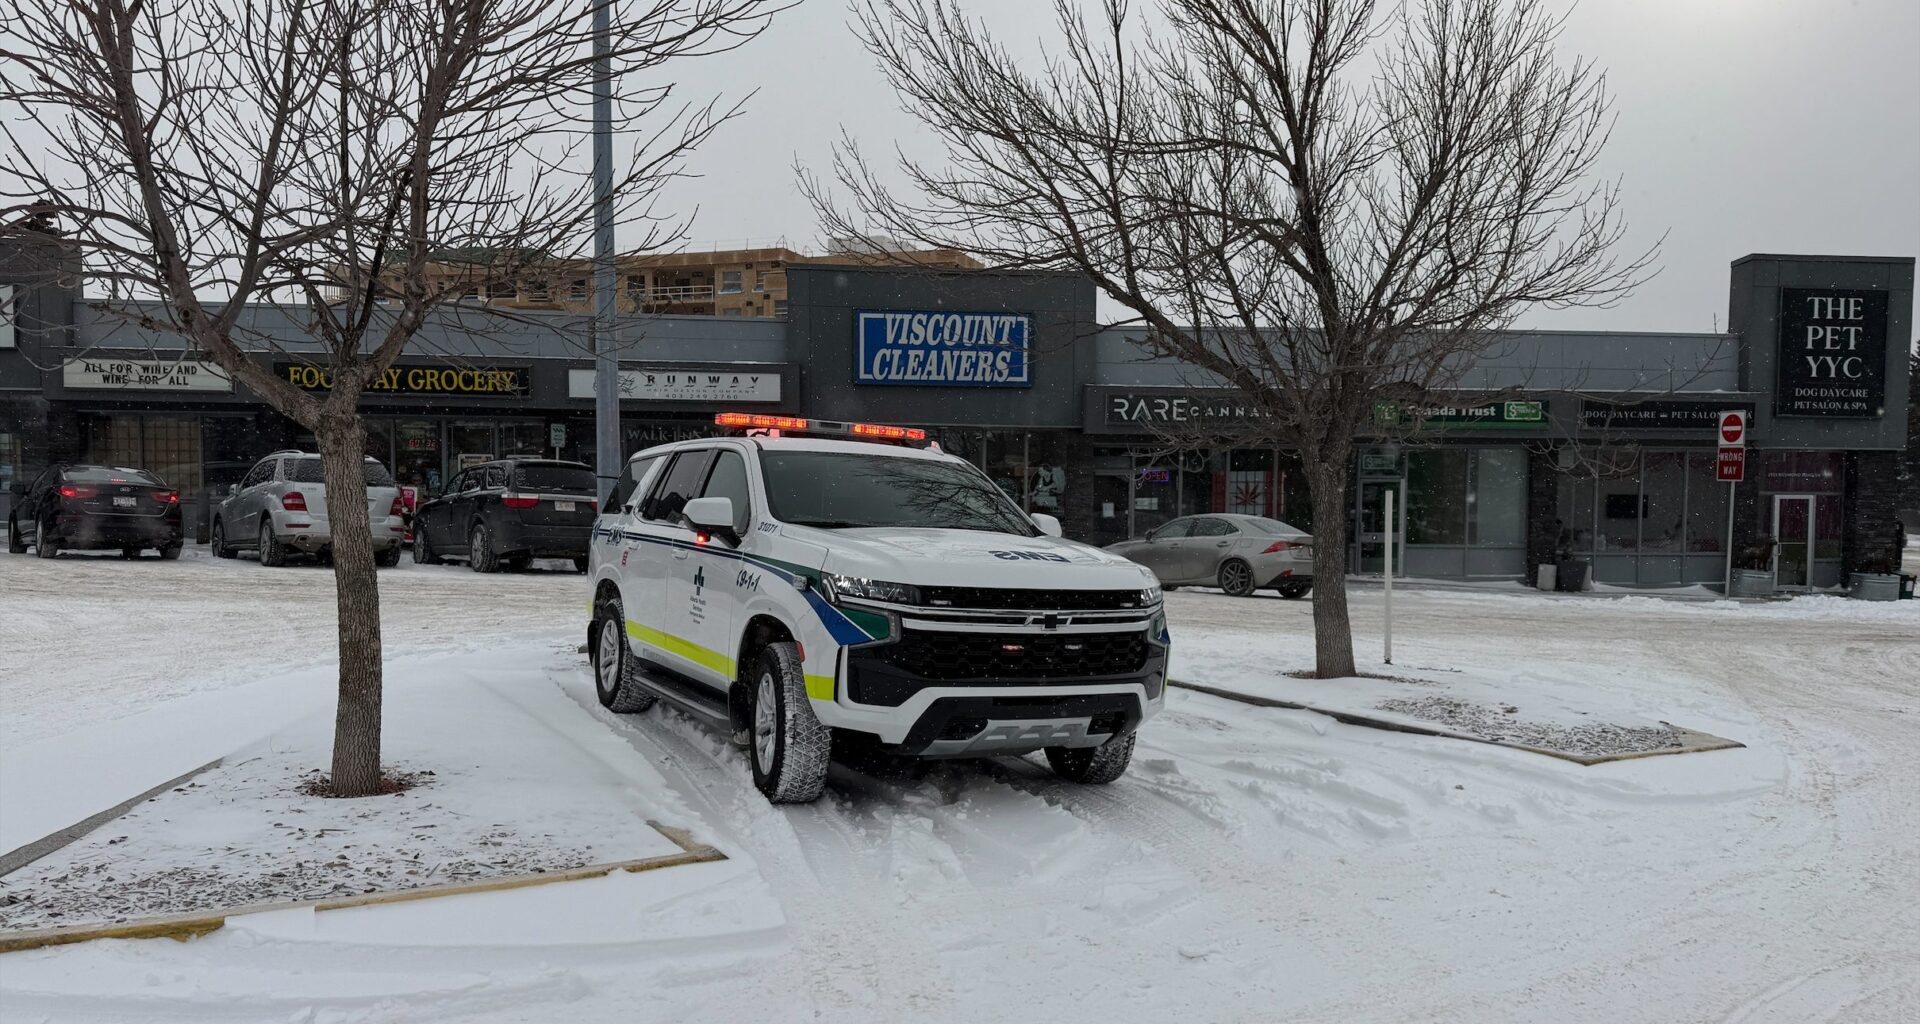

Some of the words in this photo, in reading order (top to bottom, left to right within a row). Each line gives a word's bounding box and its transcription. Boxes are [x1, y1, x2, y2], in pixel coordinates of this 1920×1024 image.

[1806, 296, 1864, 320] THE
[884, 313, 1017, 346] VISCOUNT
[1805, 325, 1863, 350] PET
[84, 363, 103, 373] ALL
[110, 363, 132, 374] FOR
[142, 365, 169, 375] WINE
[177, 365, 197, 375] AND
[872, 348, 1011, 383] CLEANERS
[1805, 356, 1863, 379] YYC
[102, 374, 129, 384] WINE
[139, 375, 159, 385] FOR
[168, 376, 189, 386] ALL
[289, 367, 402, 390] FOOAY
[408, 368, 516, 392] GROCERY
[646, 374, 760, 386] RUNWAY
[1795, 387, 1818, 397] DOG
[1820, 388, 1869, 398] DAYCARE
[1113, 398, 1188, 421] RARE
[1794, 401, 1811, 409] PET
[1812, 401, 1841, 410] SALON
[1851, 402, 1868, 410] SPA
[1585, 410, 1607, 419] DOG
[1671, 410, 1689, 419] PET
[1719, 451, 1743, 462] WRONG
[1144, 471, 1168, 481] OPEN
[1723, 465, 1737, 475] WAY
[757, 521, 779, 533] 31071
[607, 526, 625, 544] EMS
